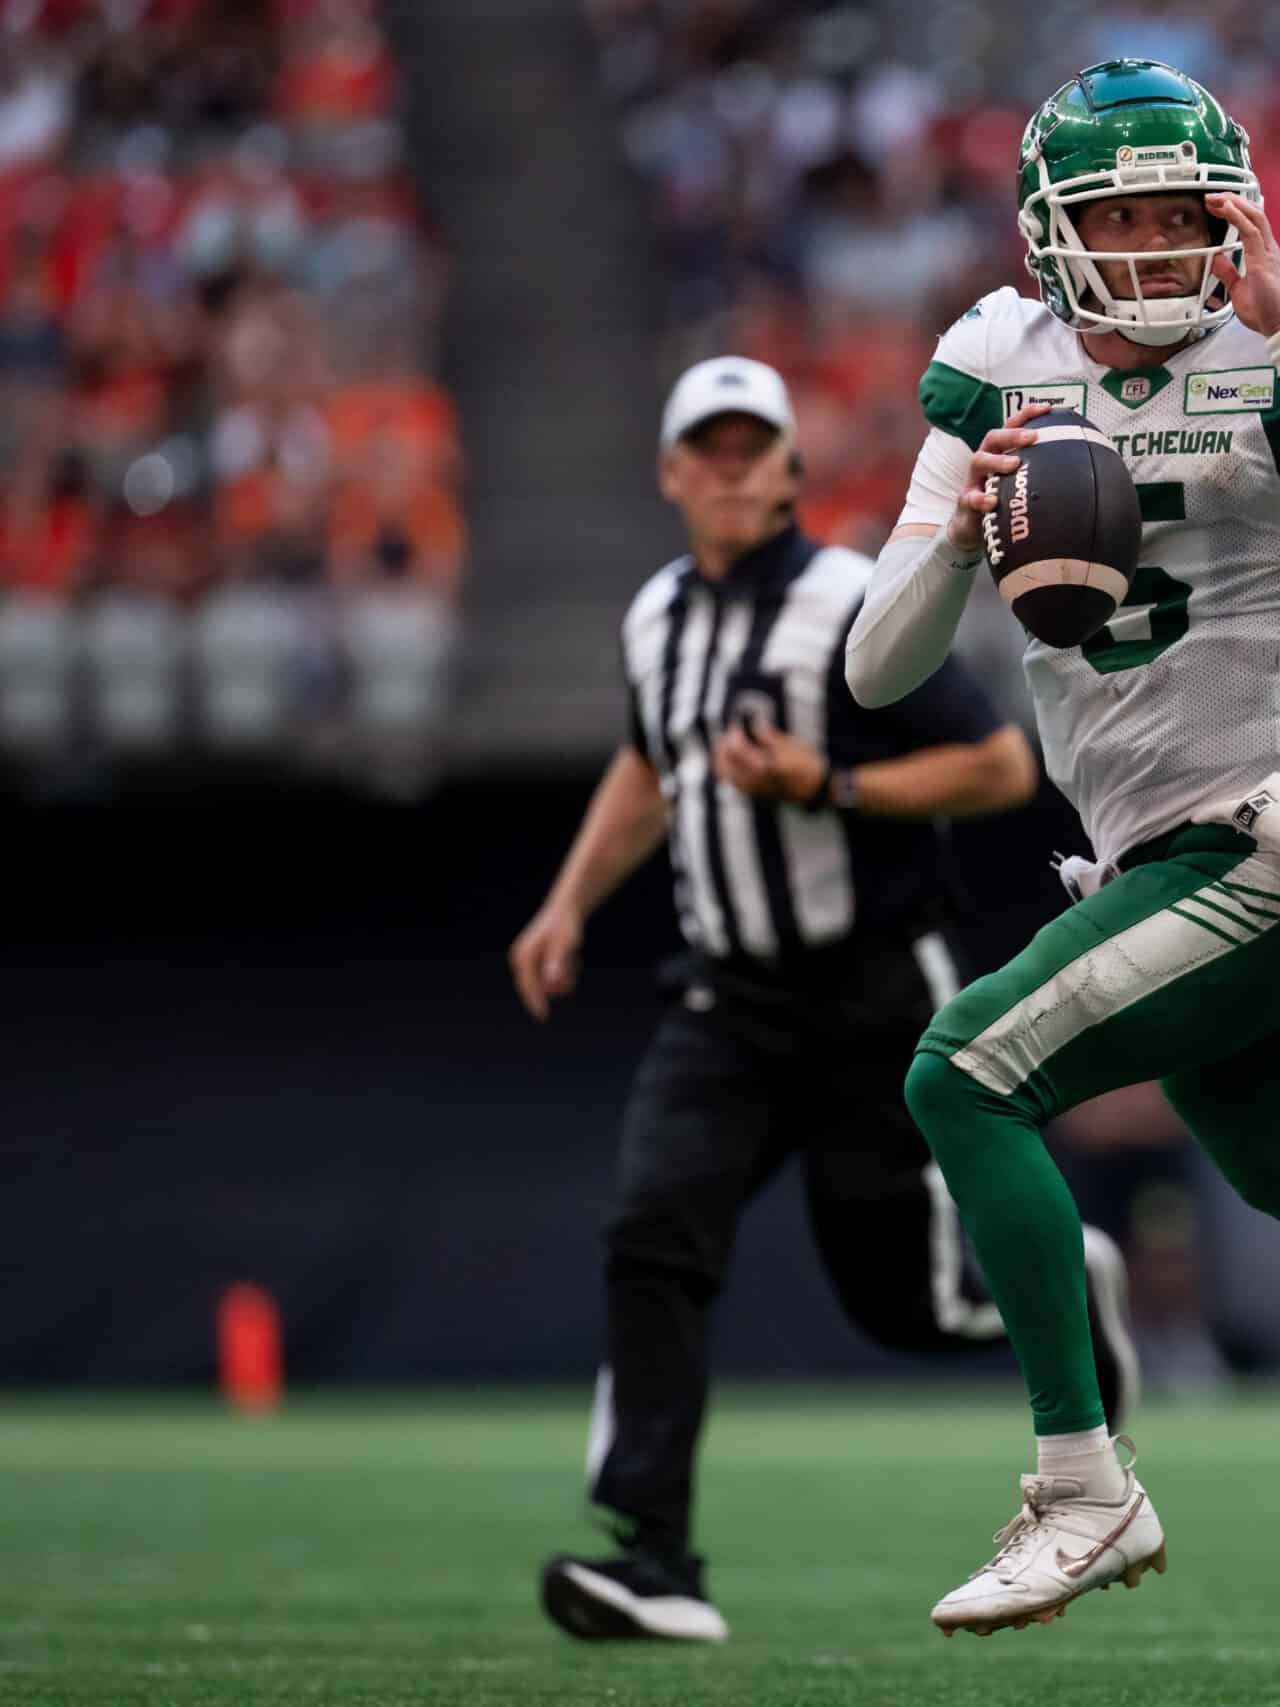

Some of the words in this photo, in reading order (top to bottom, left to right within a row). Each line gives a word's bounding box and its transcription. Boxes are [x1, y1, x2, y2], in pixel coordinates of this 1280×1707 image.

[1137, 151, 1175, 160] RIDERS
[1207, 383, 1272, 400] NexGen
[1110, 430, 1234, 457] TCHEWAN
